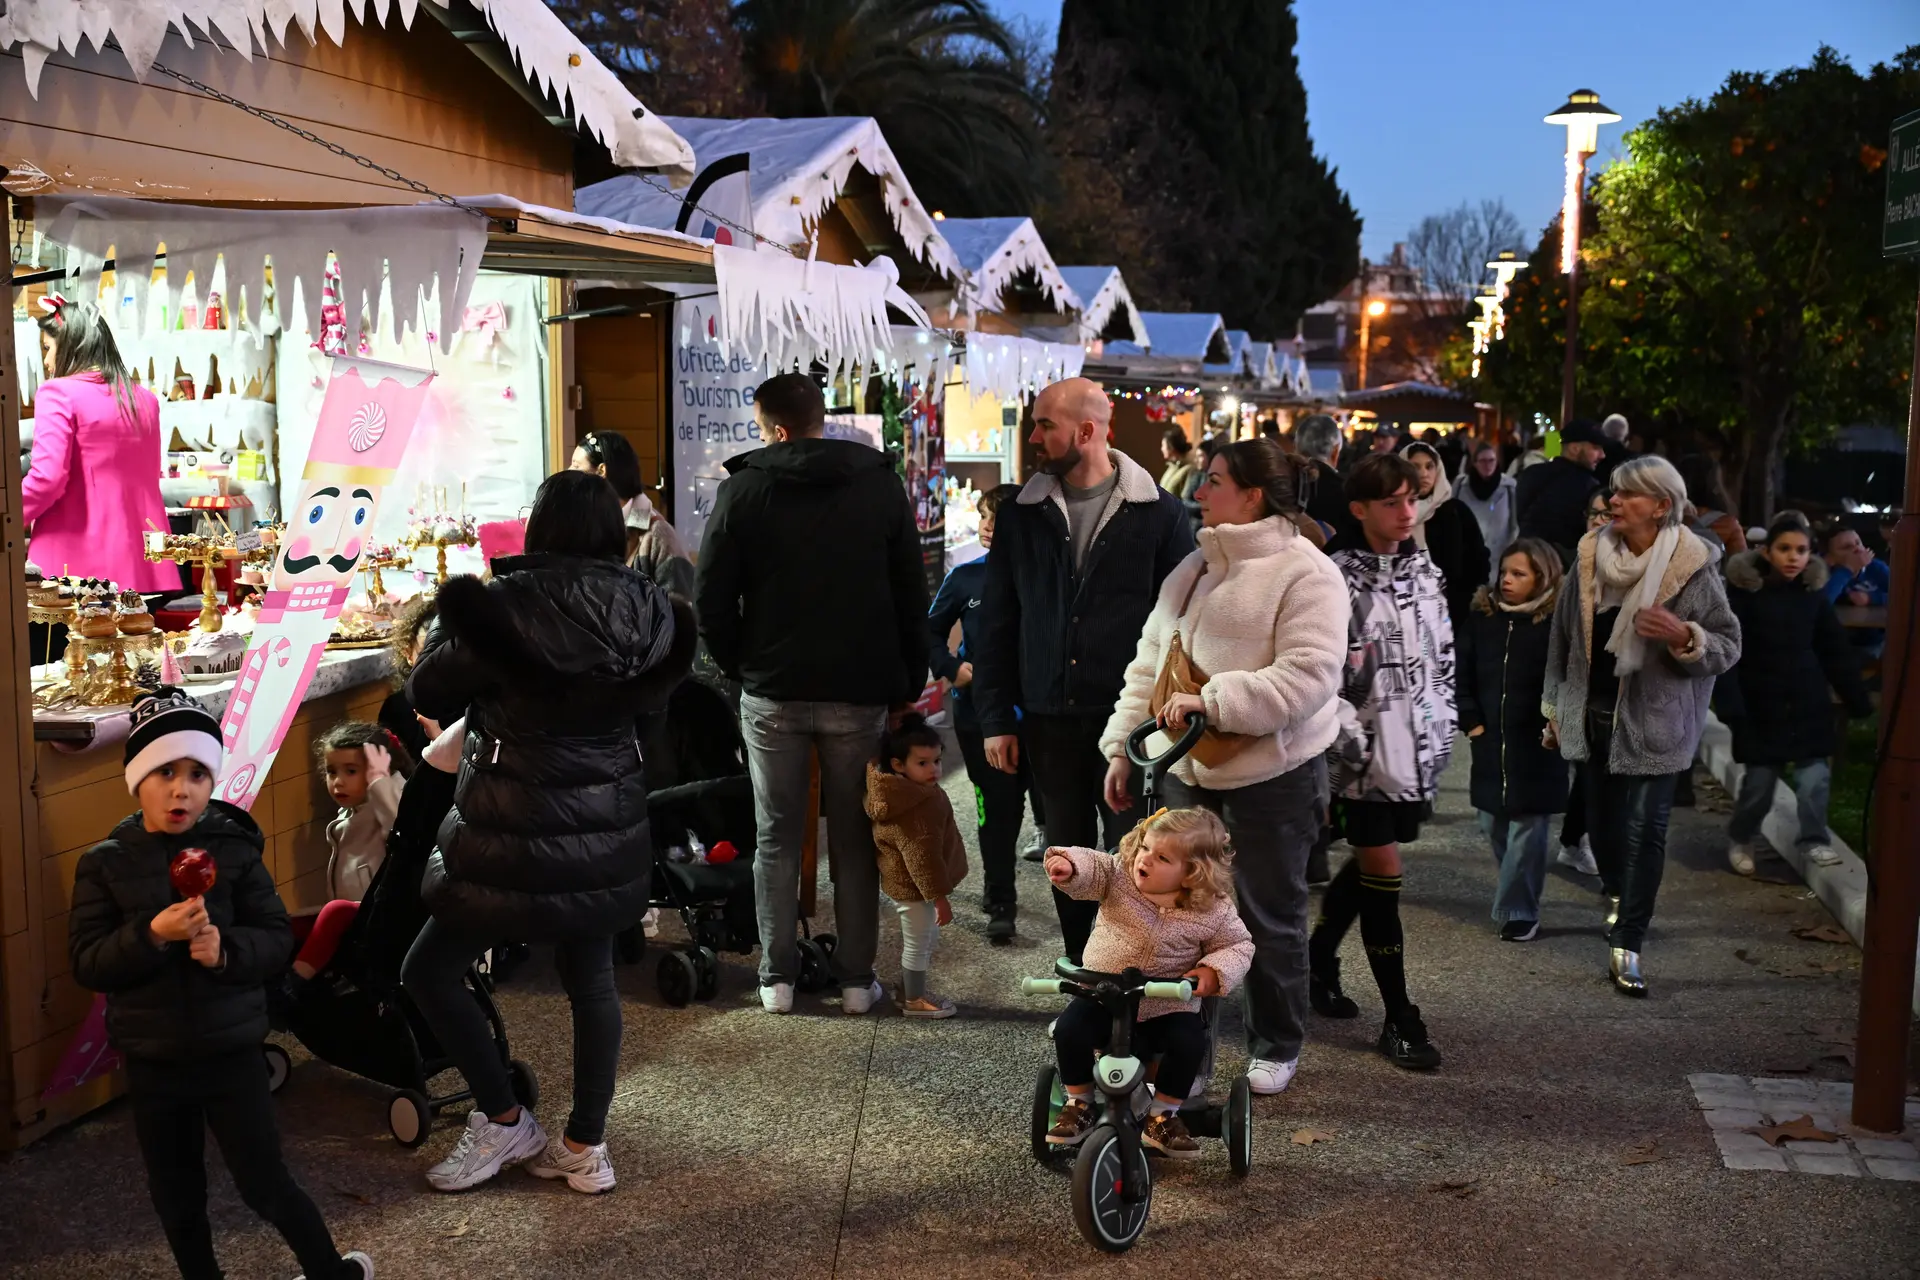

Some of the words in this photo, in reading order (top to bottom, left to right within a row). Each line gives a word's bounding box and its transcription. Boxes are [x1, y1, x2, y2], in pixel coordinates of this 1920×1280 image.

[730, 352, 752, 374] de
[680, 380, 755, 409] Tourisme
[678, 421, 693, 441] de
[698, 414, 761, 443] France
